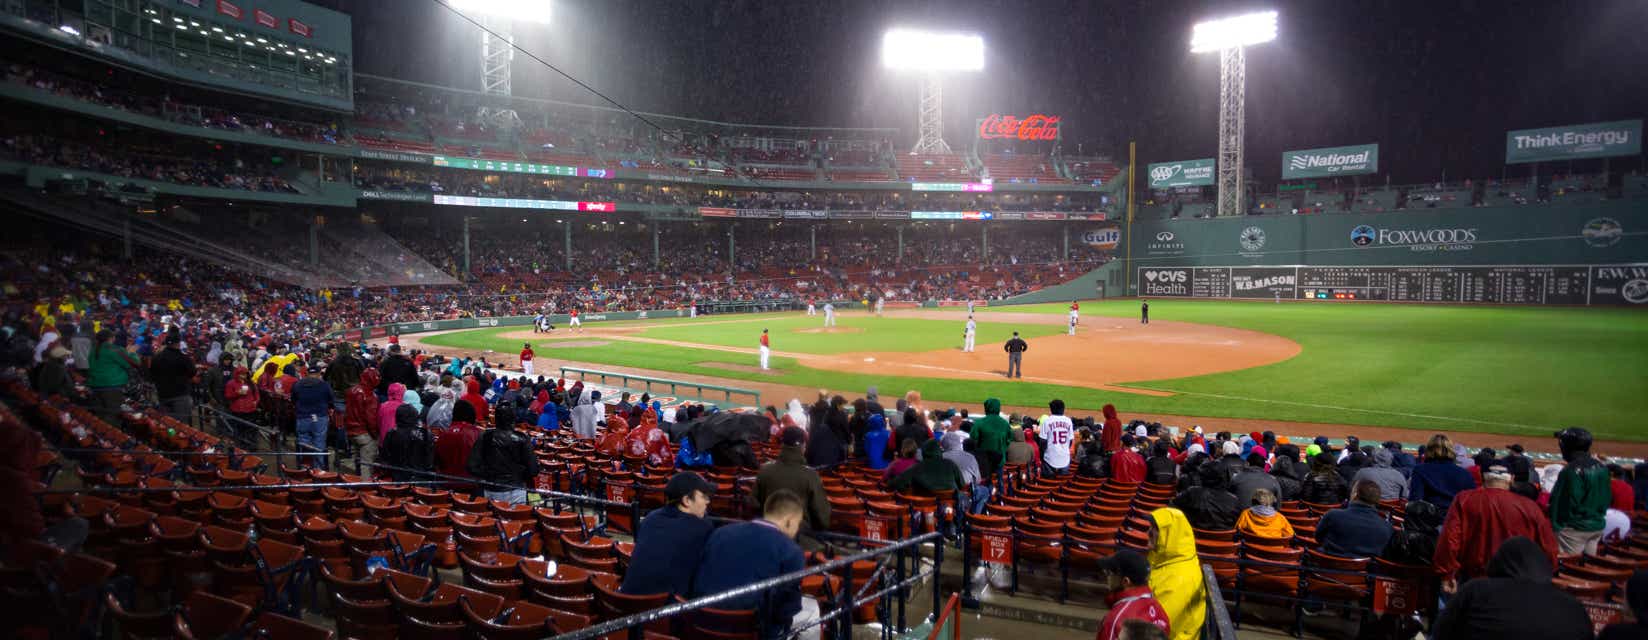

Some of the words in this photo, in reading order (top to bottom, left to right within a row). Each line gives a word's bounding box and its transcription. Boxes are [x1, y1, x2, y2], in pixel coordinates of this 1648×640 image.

[980, 114, 1059, 141] Coca-Cola
[1308, 151, 1368, 168] National
[1085, 231, 1119, 243] Gulf
[1379, 229, 1476, 245] FOXWOODS
[1158, 270, 1187, 283] CVS
[1146, 282, 1186, 295] Health
[1052, 431, 1068, 444] 15
[991, 548, 1005, 559] 17
